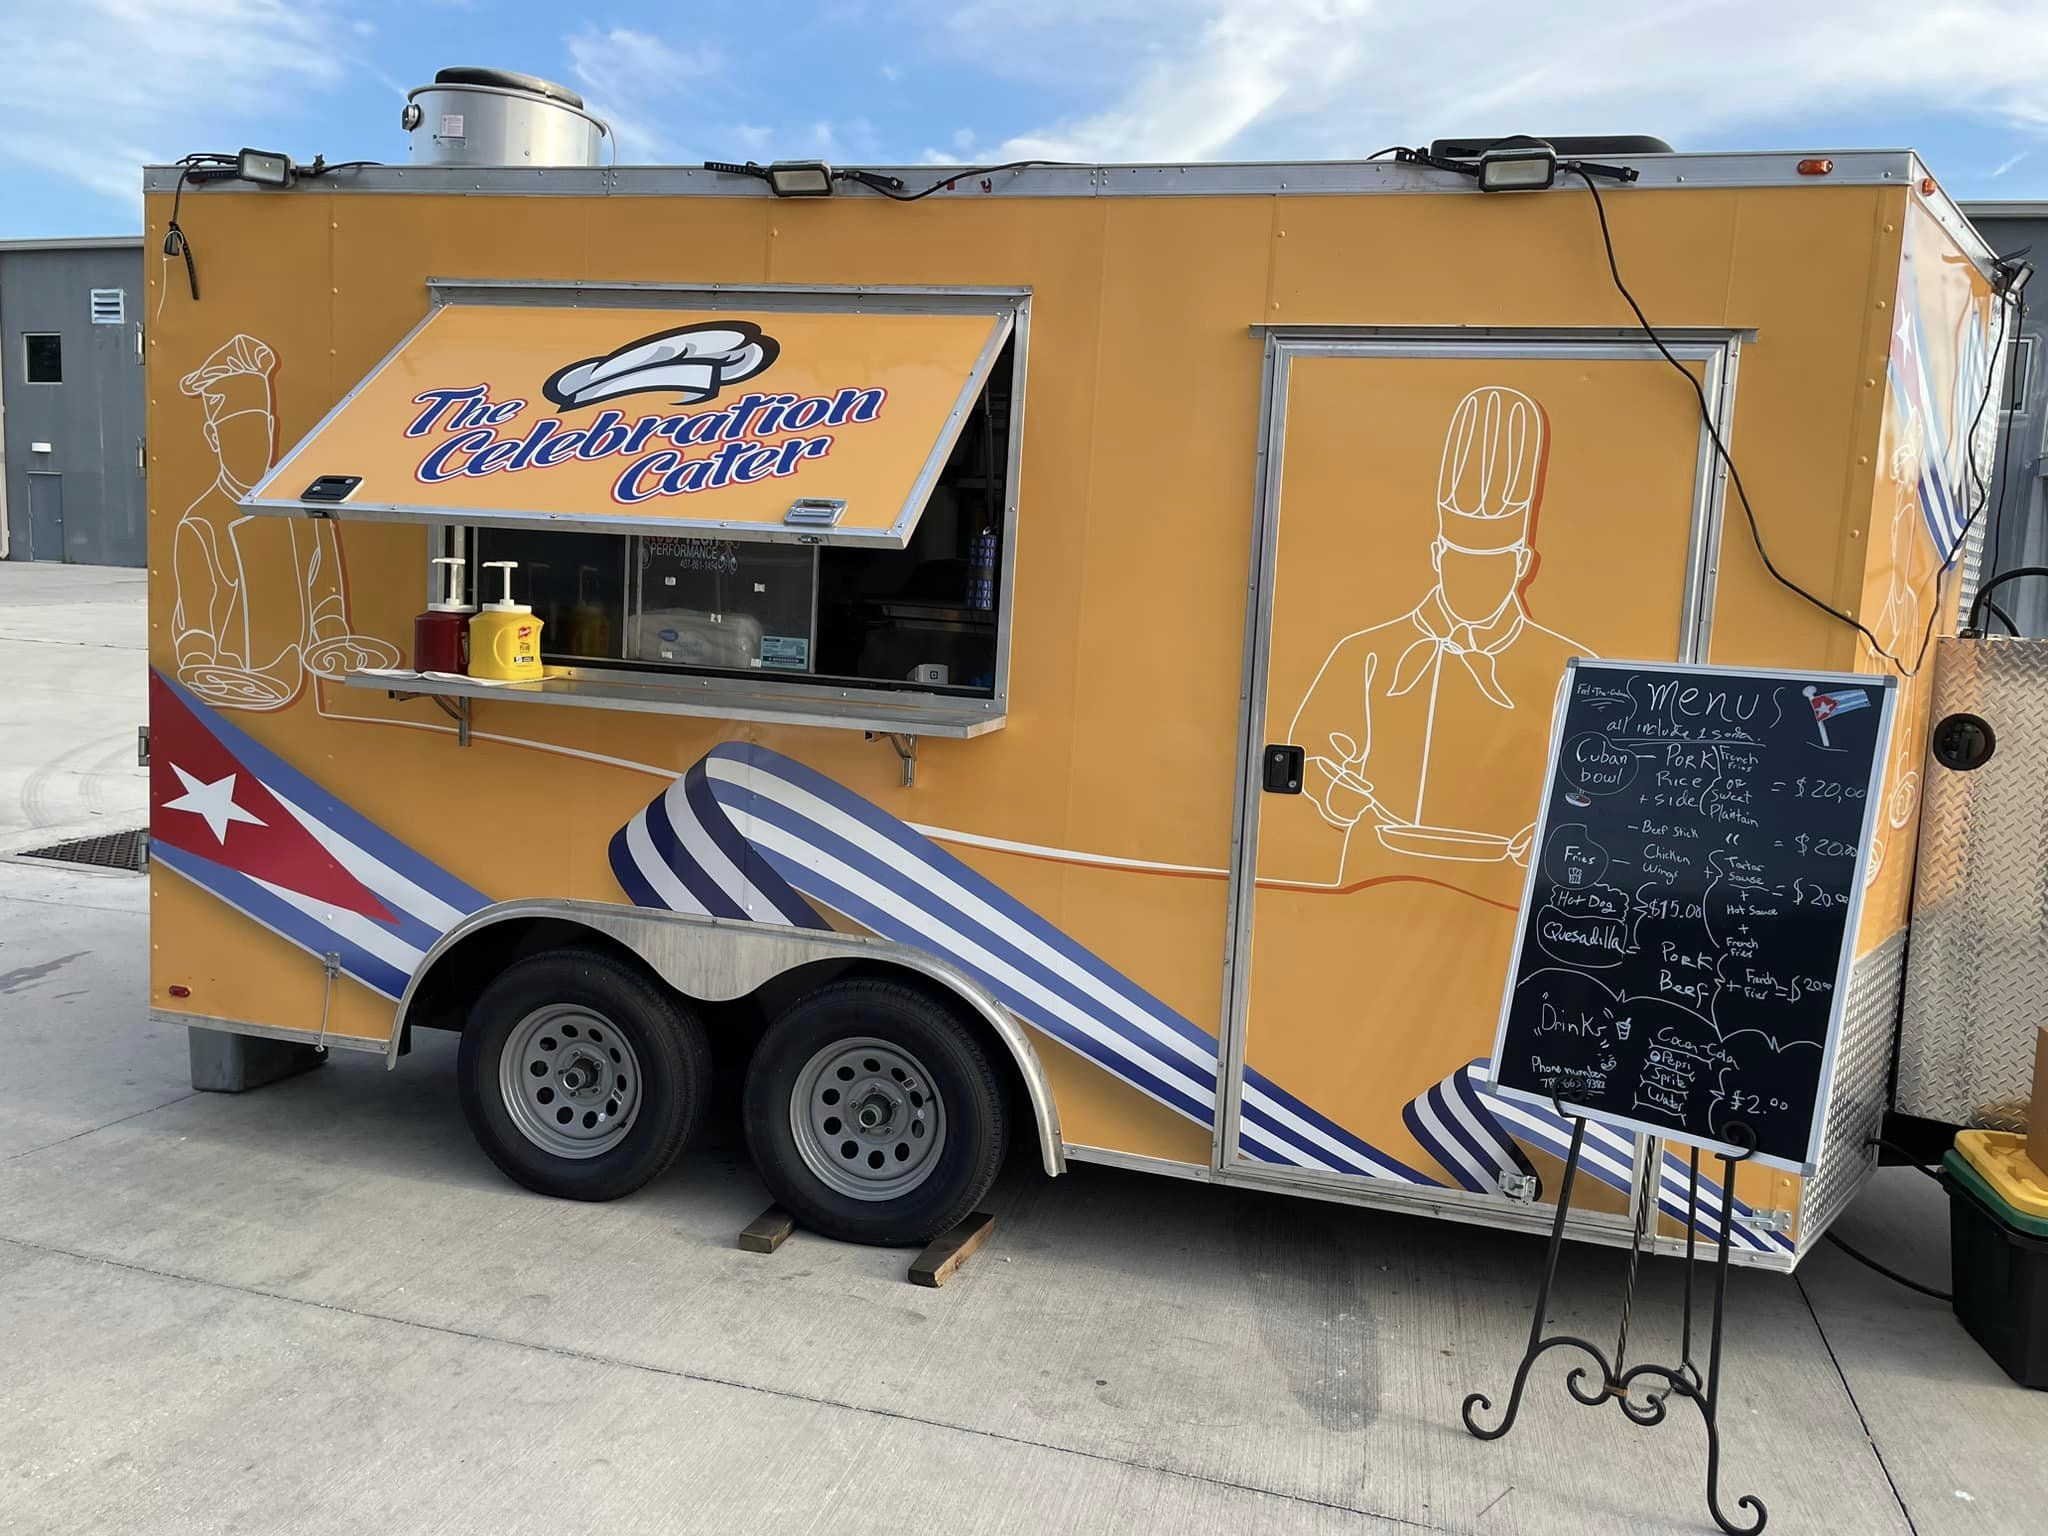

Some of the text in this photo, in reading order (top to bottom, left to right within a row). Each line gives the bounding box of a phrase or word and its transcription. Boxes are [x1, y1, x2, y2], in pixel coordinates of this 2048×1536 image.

[404, 383, 528, 438] The
[414, 387, 886, 484] Celebration
[611, 435, 834, 503] Cater
[650, 542, 718, 560] PERFORMANCE
[1575, 737, 1628, 766] Cuban
[1580, 767, 1623, 786] bowl
[1656, 770, 1703, 789] Rice
[1564, 845, 1596, 865] Fries
[1557, 890, 1617, 914] Hot Dog
[1726, 903, 1746, 915] Hot
[1530, 1055, 1562, 1074] Phone
[1650, 1066, 1687, 1089] Sprite
